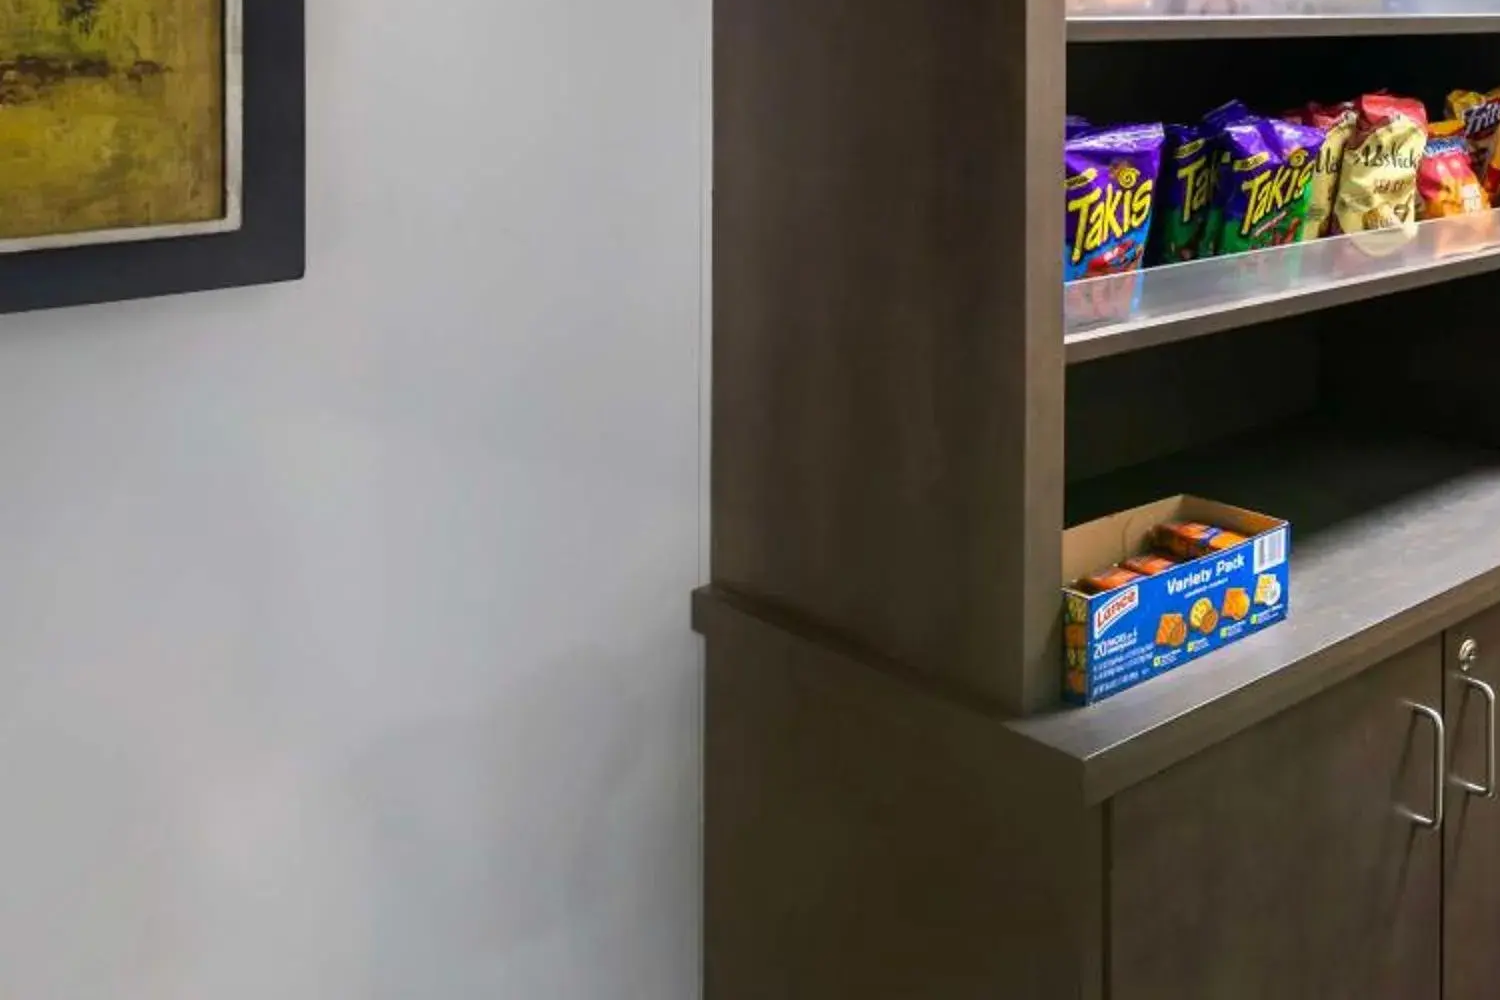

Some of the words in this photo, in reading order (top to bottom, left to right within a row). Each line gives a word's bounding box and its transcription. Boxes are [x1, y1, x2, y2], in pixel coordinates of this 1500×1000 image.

[1068, 179, 1153, 263] Takis
[1177, 154, 1220, 223] Tak
[1241, 159, 1317, 236] Takis
[1096, 588, 1136, 629] Lance
[1166, 568, 1212, 596] Variety
[1215, 553, 1245, 577] Pack
